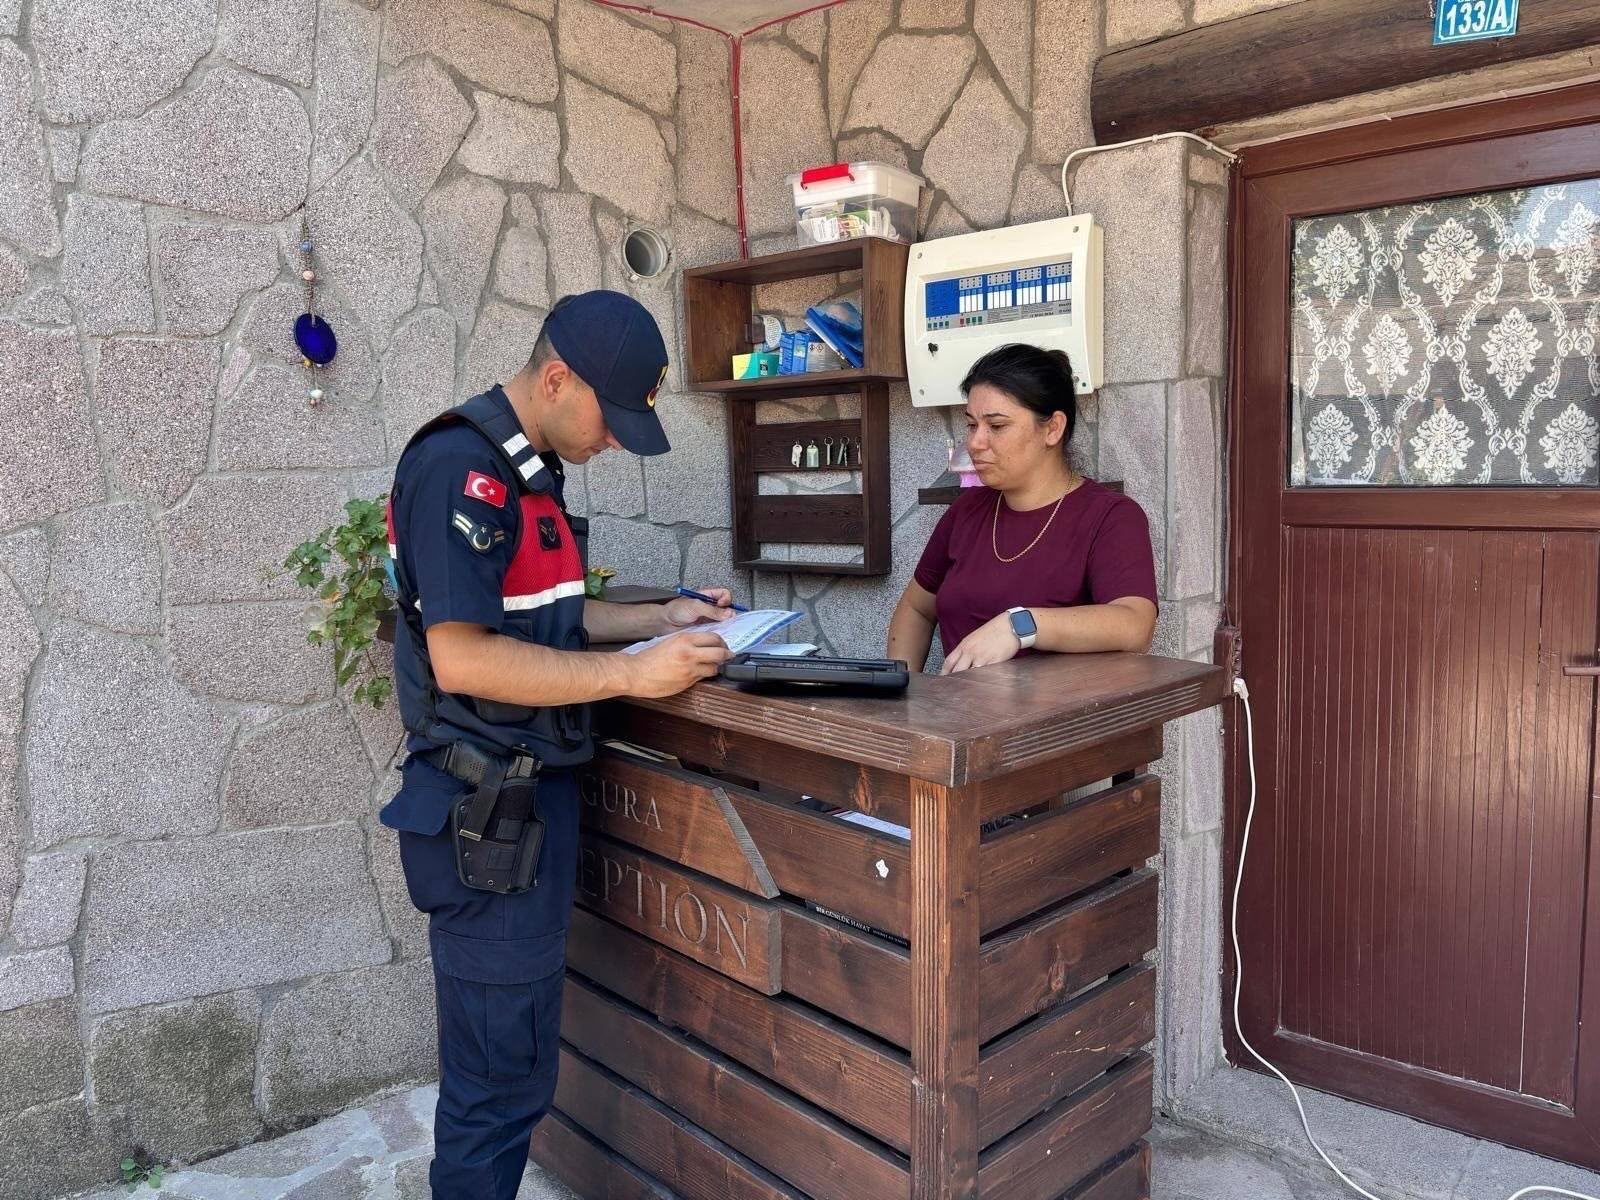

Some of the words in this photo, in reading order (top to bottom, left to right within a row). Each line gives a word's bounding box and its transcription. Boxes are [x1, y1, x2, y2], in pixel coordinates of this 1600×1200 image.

[1446, 0, 1508, 36] 133/A
[580, 774, 664, 833] GURA
[579, 848, 751, 969] EPTION
